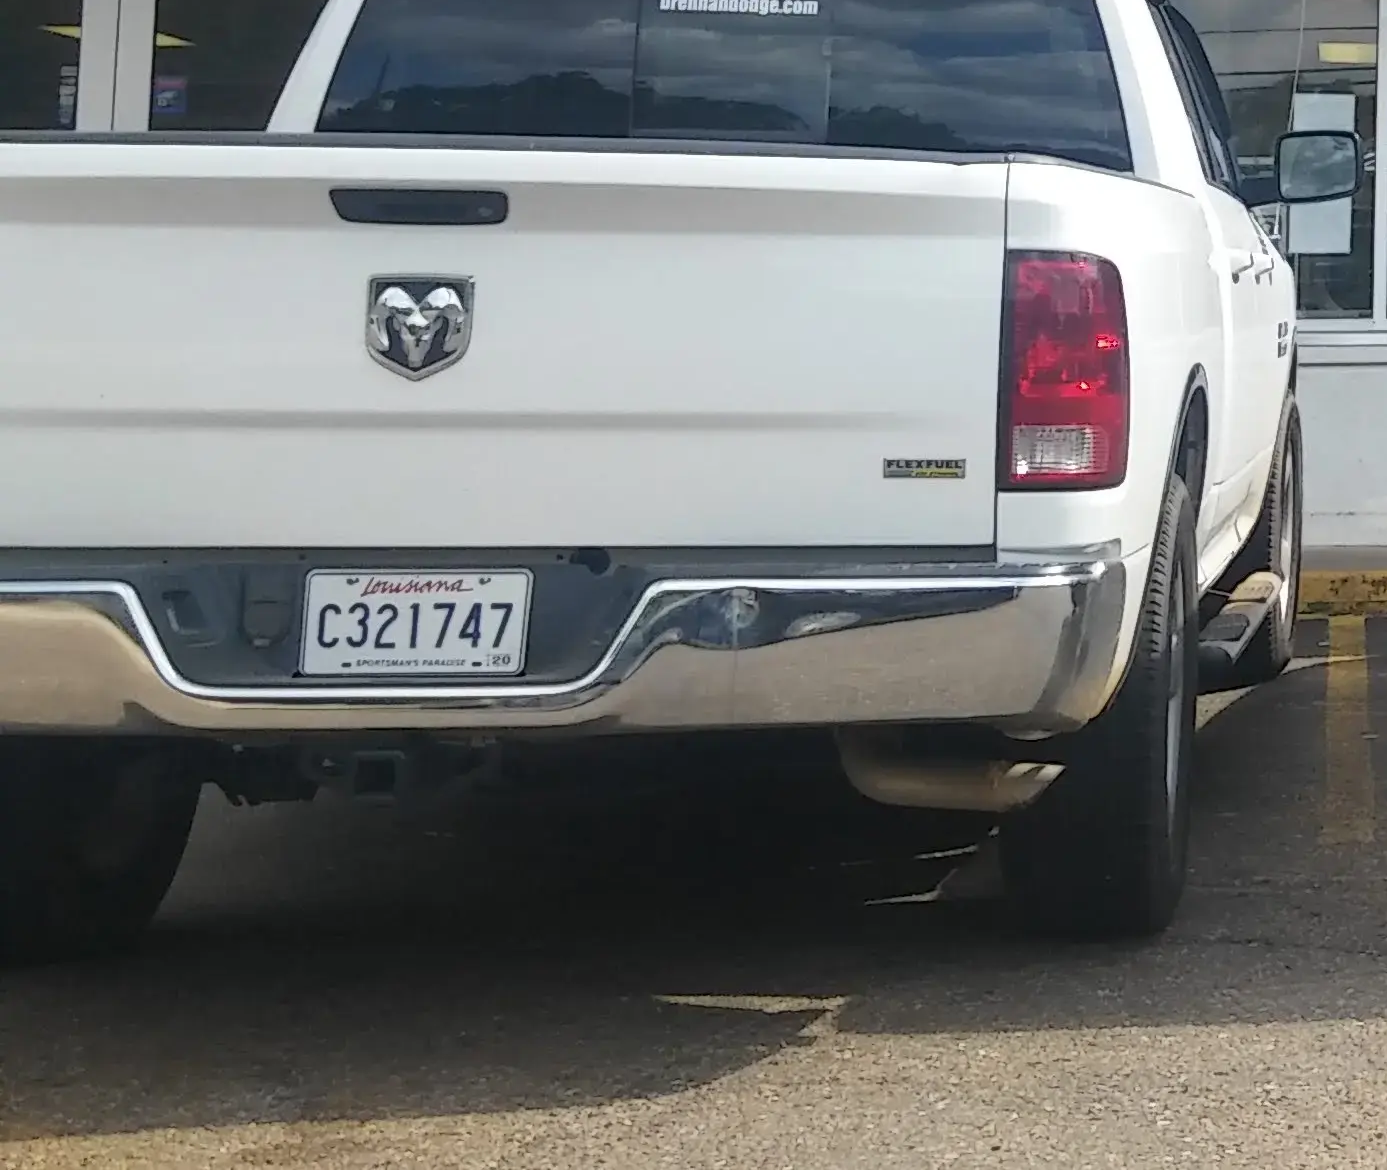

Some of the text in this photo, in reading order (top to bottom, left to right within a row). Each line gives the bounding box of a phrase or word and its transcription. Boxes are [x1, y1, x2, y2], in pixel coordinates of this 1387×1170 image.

[887, 460, 963, 468] FLEXFUEL
[361, 575, 474, 598] Louisiana
[317, 602, 514, 650] C321747
[491, 654, 512, 667] 20
